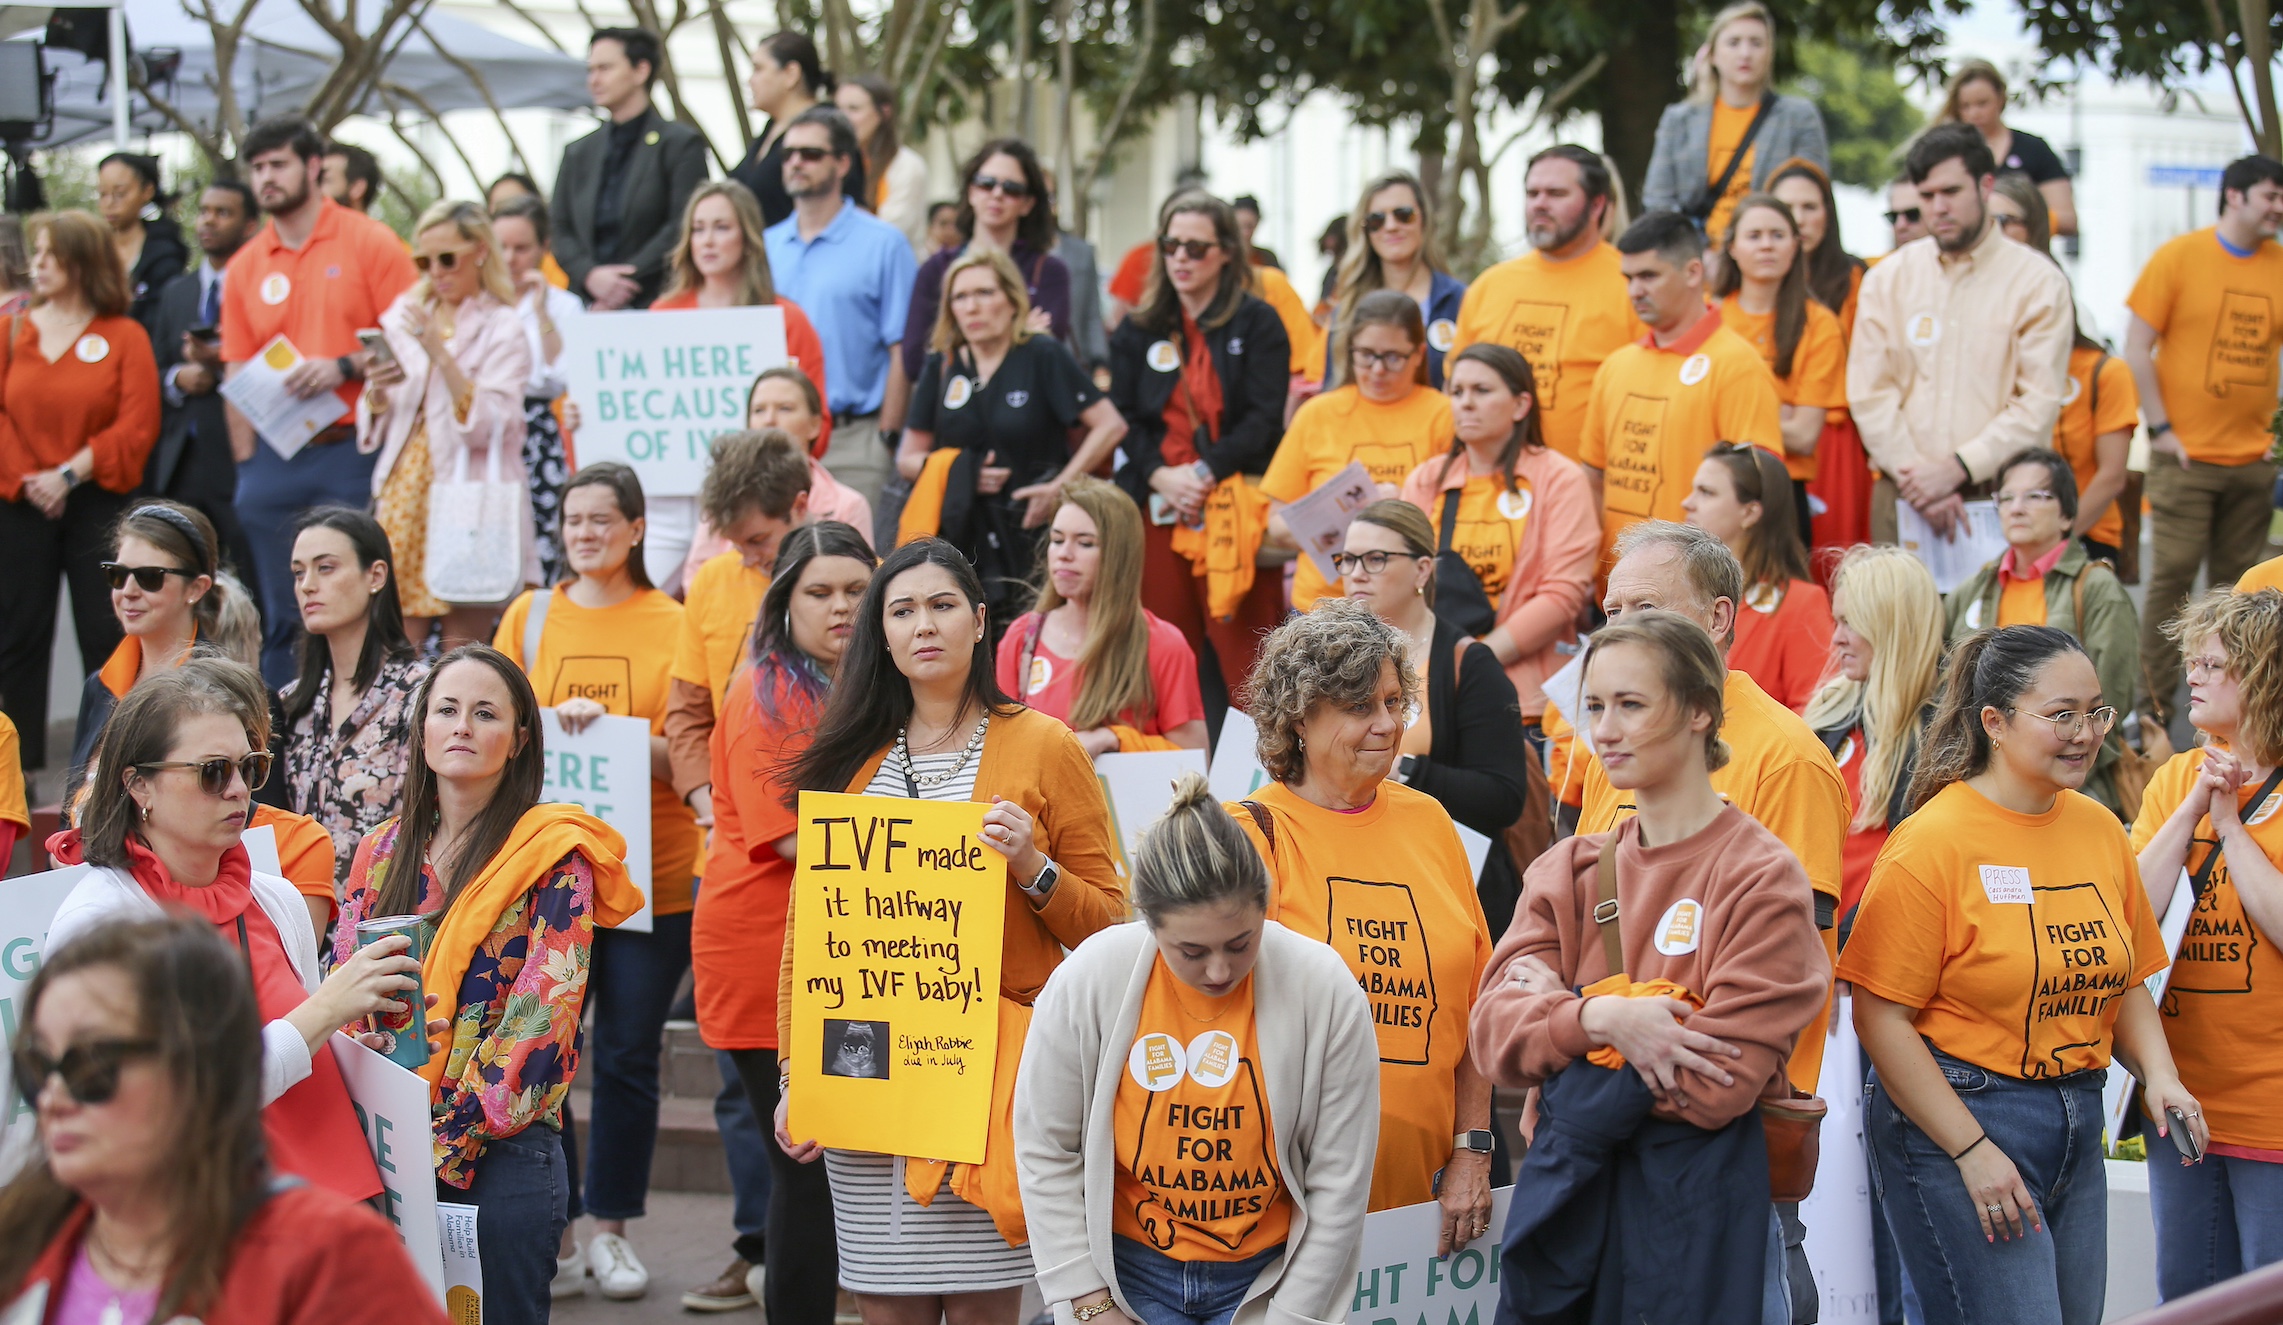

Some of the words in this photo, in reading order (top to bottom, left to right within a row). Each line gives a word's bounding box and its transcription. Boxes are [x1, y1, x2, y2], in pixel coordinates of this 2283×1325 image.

[596, 347, 647, 380] I'M
[664, 344, 754, 378] HERE
[625, 429, 671, 461] OF
[568, 684, 620, 698] FIGHT
[917, 835, 986, 871] made
[1984, 868, 2021, 886] PRESS
[823, 886, 850, 918] it
[865, 887, 962, 938] halfway
[1346, 917, 1408, 941] FIGHT
[2045, 920, 2108, 944] FIGHT
[825, 931, 851, 959] to
[862, 935, 960, 975] meeting
[1358, 943, 1402, 968] FOR
[2061, 946, 2109, 969] FOR
[2177, 942, 2241, 962] MILIES
[807, 977, 844, 1010] my
[859, 969, 905, 999] IVF
[915, 967, 983, 1014] baby!
[1358, 971, 1428, 999] ABAMA
[2038, 971, 2127, 998] ALABAMA
[1369, 1002, 1422, 1028] ILIES
[898, 1034, 936, 1056] Elijah
[1148, 1044, 1166, 1052] FIGHT
[1152, 1050, 1165, 1058] FOR
[1212, 1048, 1225, 1057] FOR
[1213, 1041, 1229, 1051] FIGHT
[903, 1054, 922, 1067] due
[926, 1054, 938, 1066] in
[941, 1053, 966, 1075] July
[1146, 1057, 1173, 1065] ALABAMA
[1147, 1062, 1173, 1071] FAMILIES
[1202, 1057, 1225, 1070] FAMILIES
[1204, 1052, 1228, 1064] ALABAMA
[1167, 1103, 1245, 1131] FIGHT
[1176, 1136, 1233, 1162] FOR
[1140, 1164, 1269, 1192] ALABAMA
[446, 1213, 456, 1253] Alabama
[455, 1214, 465, 1250] Families
[460, 1250, 467, 1258] in
[464, 1215, 473, 1236] Help
[466, 1237, 476, 1259] Build
